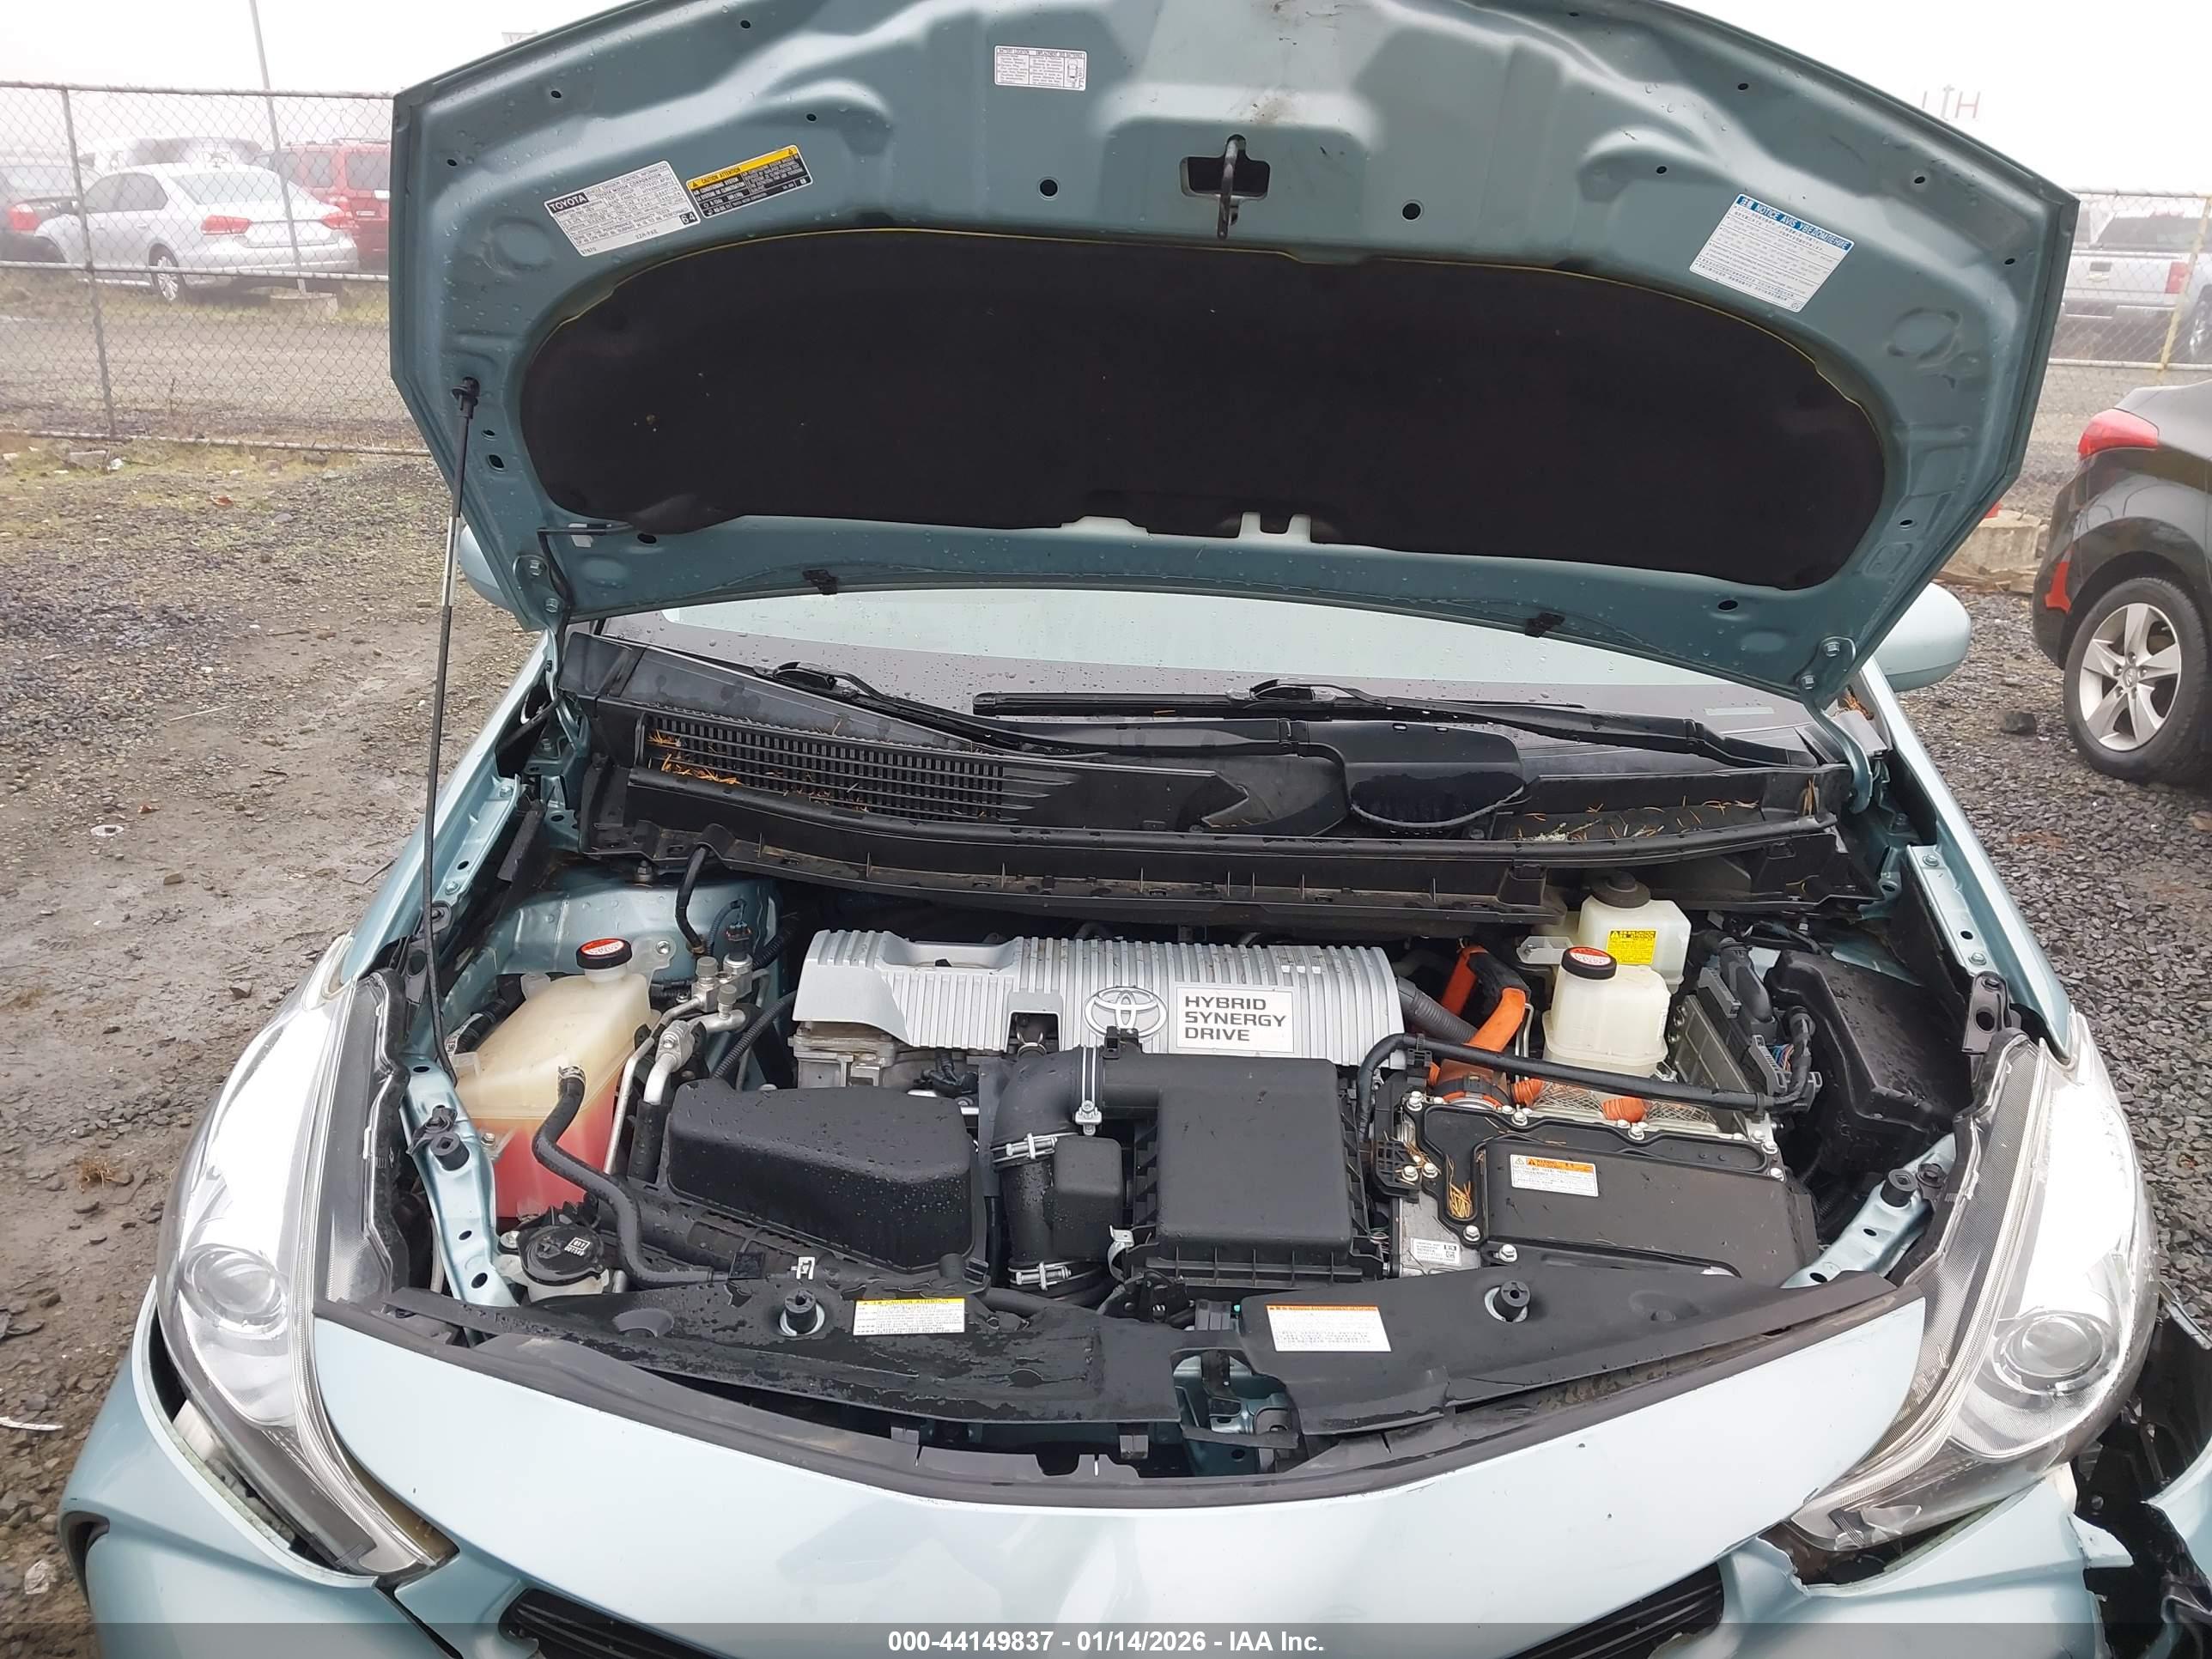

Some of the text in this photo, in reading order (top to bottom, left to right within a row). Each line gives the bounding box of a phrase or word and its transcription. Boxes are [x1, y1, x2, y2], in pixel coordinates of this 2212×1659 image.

[701, 167, 740, 184] CAUTION ATTENTION
[550, 194, 587, 211] TOYOTA
[681, 213, 696, 224] 64
[1755, 204, 1780, 220] NOTICE
[1781, 215, 1798, 228] AVIS
[1799, 222, 1850, 248] УВЕДОМЛЕНИЕ
[1185, 996, 1266, 1010] HYBRID
[1185, 1012, 1286, 1027] SYNERGY
[1185, 1027, 1250, 1041] DRIVE
